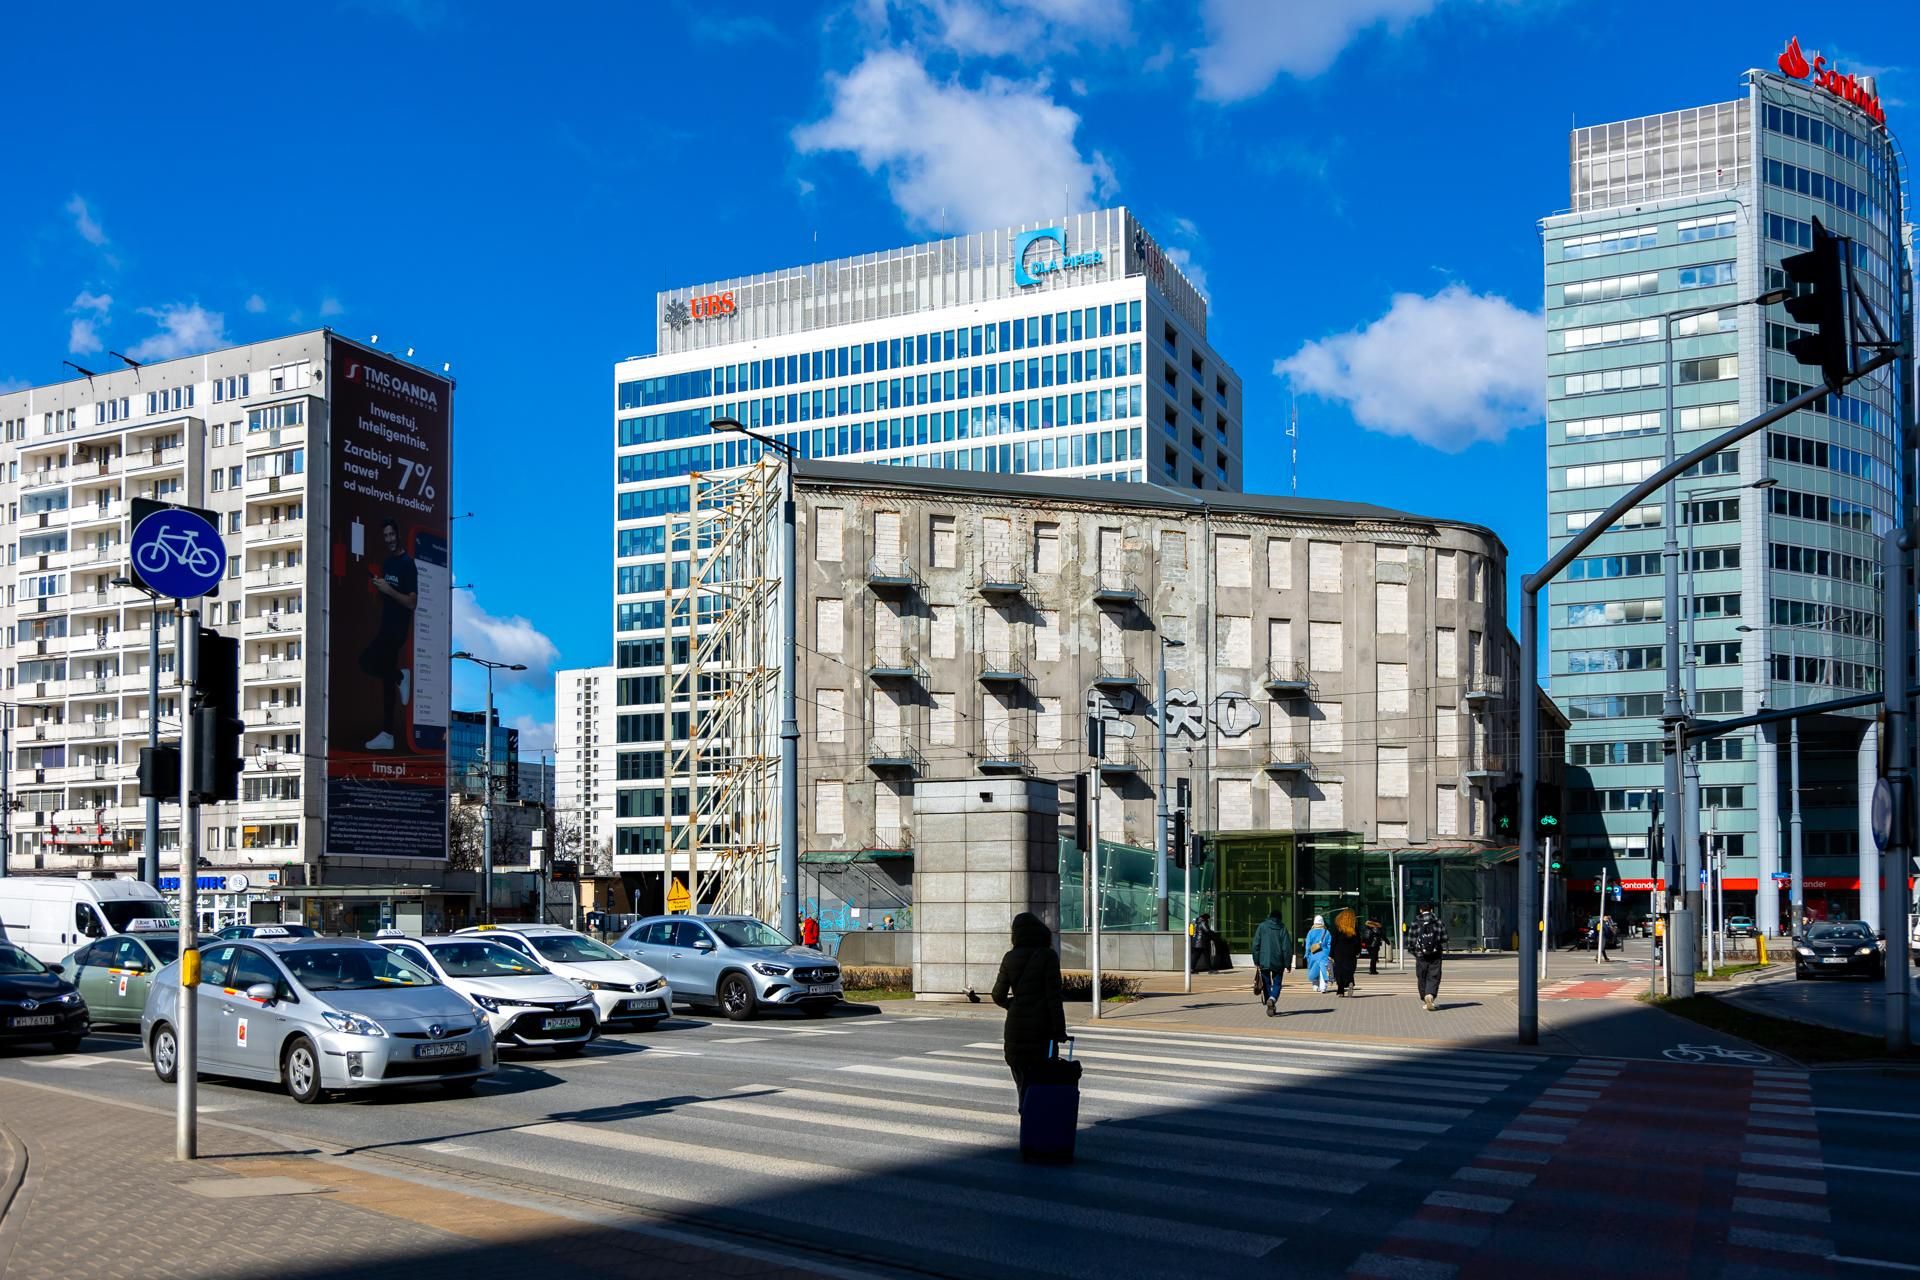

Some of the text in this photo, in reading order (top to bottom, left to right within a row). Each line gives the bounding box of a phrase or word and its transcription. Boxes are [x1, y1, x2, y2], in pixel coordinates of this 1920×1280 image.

[1031, 250, 1103, 274] DLA PIPER
[690, 291, 735, 318] UBS
[391, 377, 438, 405] OANDA
[370, 402, 419, 432] Inwestuj.
[358, 416, 430, 451] Inteligentnie.
[344, 439, 392, 469] Zarabiaj
[344, 462, 379, 480] nawet
[398, 457, 435, 499] 7%
[344, 480, 356, 491] od
[358, 484, 395, 502] wolnych
